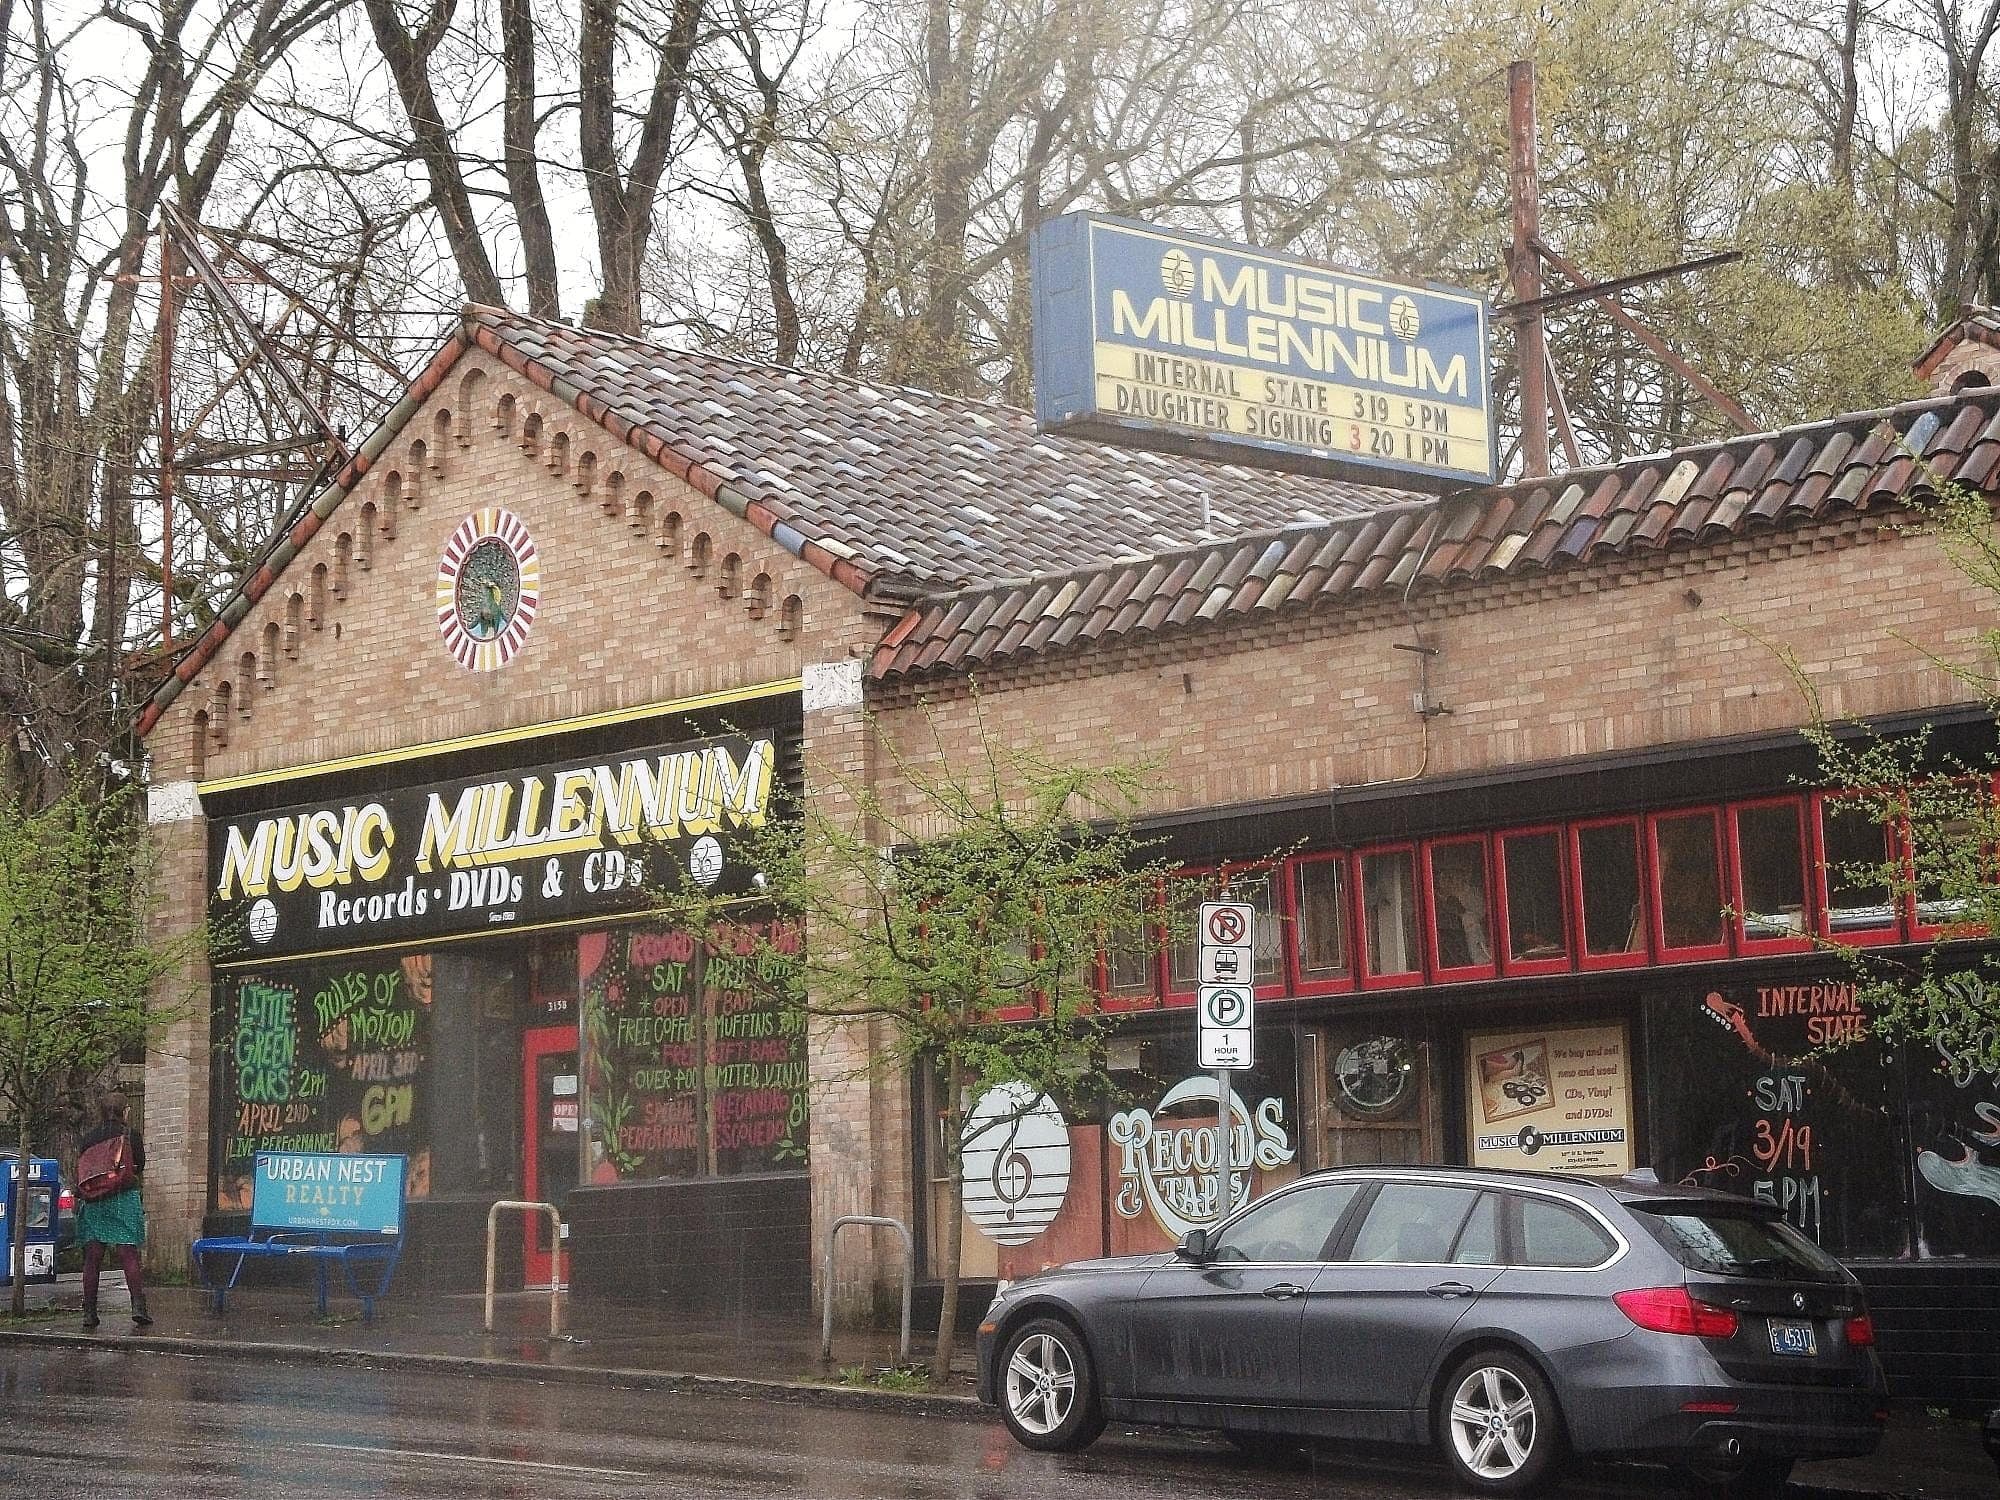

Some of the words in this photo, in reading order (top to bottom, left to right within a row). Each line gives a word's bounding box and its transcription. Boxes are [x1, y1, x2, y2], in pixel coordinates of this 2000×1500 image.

[1202, 257, 1384, 336] MUSIC
[1113, 288, 1468, 399] MILLENNIUM
[1134, 352, 1240, 397] INTERNAL
[1265, 377, 1328, 412] STATE
[1116, 384, 1229, 429] DAUGHTER
[1247, 407, 1332, 446] SIGNING
[218, 802, 395, 900] MUSIC
[415, 739, 775, 873] MILLENNIUM
[318, 877, 427, 929] Records
[449, 866, 523, 911] DVDs
[541, 858, 563, 898] &
[584, 850, 644, 893] CDs
[652, 962, 687, 993] SAT
[314, 971, 369, 1033] RULES
[374, 970, 401, 1007] OF
[1218, 998, 1236, 1019] P
[1756, 982, 1861, 1018] INTERNAL
[351, 1006, 416, 1051] MOTION
[617, 1017, 651, 1049] FREE
[715, 1012, 774, 1038] MUFFINS
[1222, 1034, 1229, 1046] 1
[1807, 1015, 1867, 1045] STATE
[235, 1026, 295, 1069] GREEN
[1214, 1047, 1238, 1055] HOUR
[1586, 1046, 1602, 1057] and
[240, 1066, 289, 1101] CARS
[299, 1069, 326, 1098] 2PM
[635, 1069, 672, 1091] OVER
[1558, 1070, 1576, 1078] new
[1577, 1065, 1595, 1077] and
[1597, 1063, 1617, 1076] used
[1587, 1085, 1612, 1099] Vinyl
[1755, 1076, 1806, 1113] SAT
[238, 1103, 283, 1136] APRIL
[286, 1103, 309, 1123] 2ND
[553, 1104, 578, 1117] OPE
[1565, 1108, 1582, 1120] and
[1584, 1107, 1613, 1119] DVDs!
[261, 1132, 337, 1152] PERFORMANCE
[1108, 1096, 1297, 1178] RECORDS
[1480, 1136, 1517, 1149] MUSIC
[1542, 1130, 1623, 1145] MILLENNIUM
[1753, 1118, 1811, 1173] 3/19
[267, 1158, 332, 1182] URBAN
[339, 1160, 387, 1184] NEST
[286, 1184, 366, 1207] REALTY
[1160, 1171, 1244, 1217] TAPS
